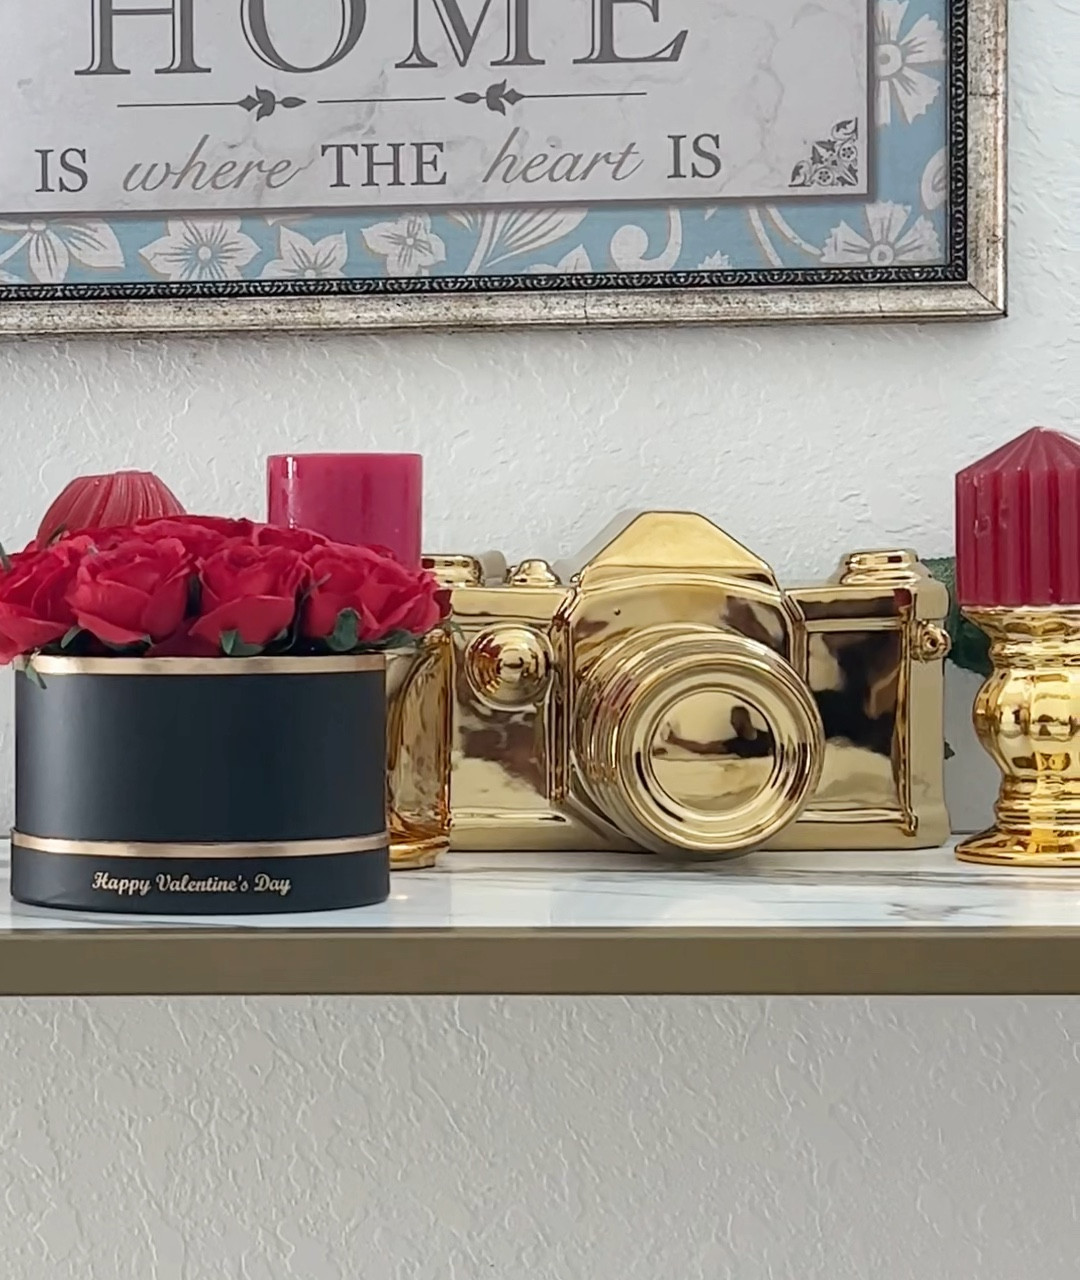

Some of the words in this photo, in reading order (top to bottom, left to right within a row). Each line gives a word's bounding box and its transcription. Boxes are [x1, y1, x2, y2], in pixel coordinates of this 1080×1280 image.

[33, 147, 89, 193] IS
[121, 134, 314, 193] where
[320, 142, 448, 189] THE
[481, 126, 645, 185] heart
[666, 132, 722, 181] IS
[91, 871, 152, 896] Happy
[155, 873, 249, 893] Valentine's
[253, 874, 292, 897] Day
